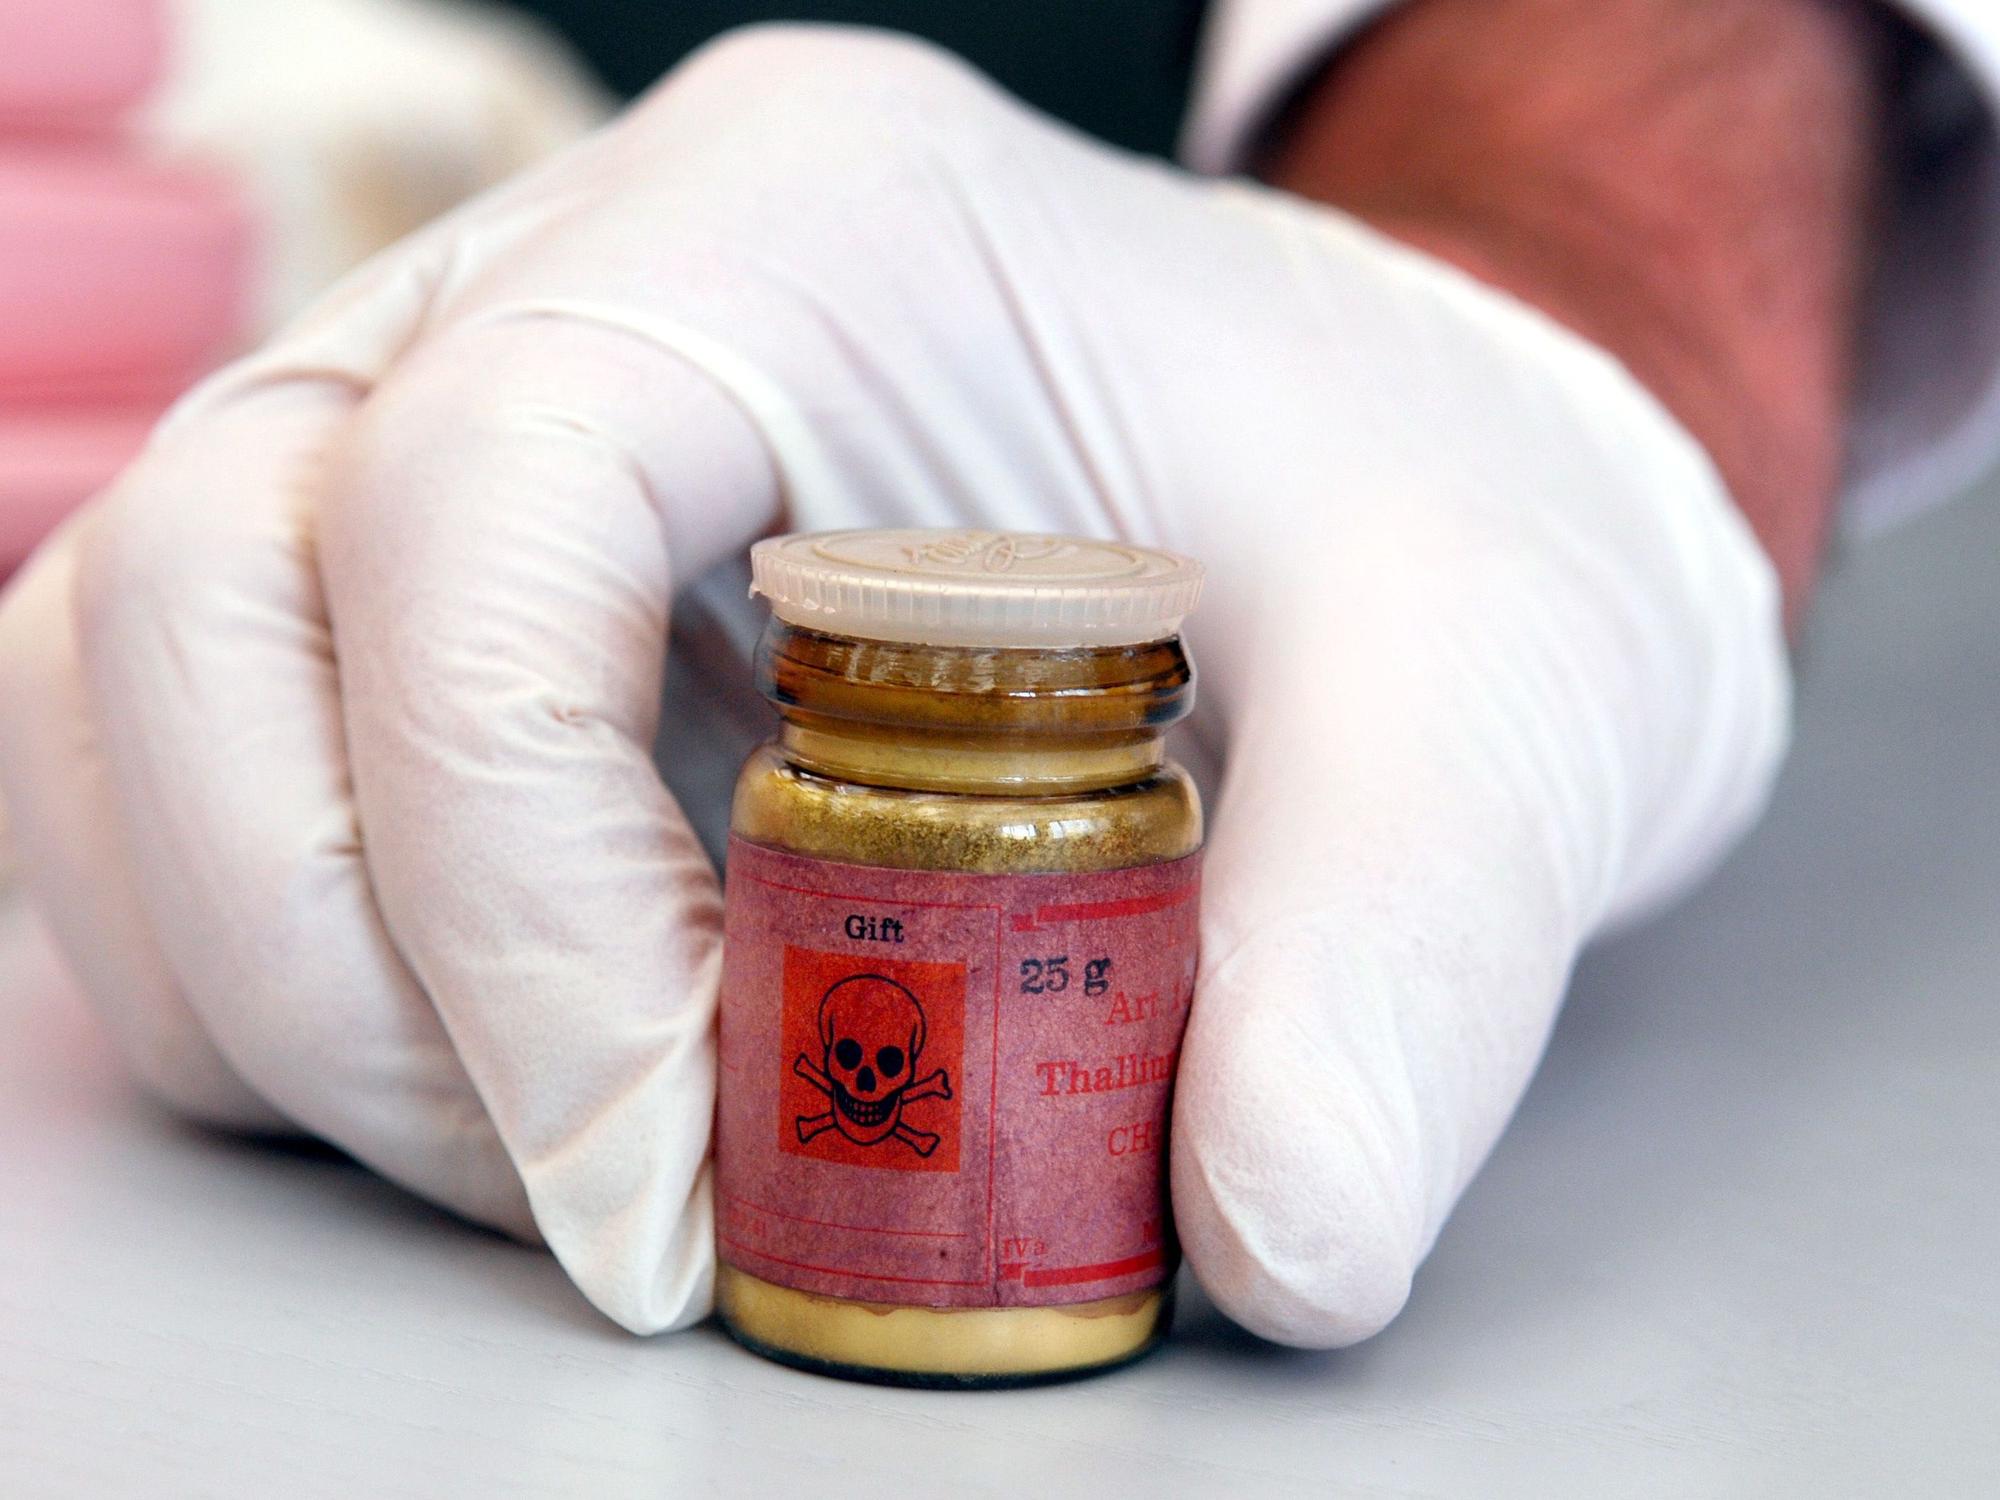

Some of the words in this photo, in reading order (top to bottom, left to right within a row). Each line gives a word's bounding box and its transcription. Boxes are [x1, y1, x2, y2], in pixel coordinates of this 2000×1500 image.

[844, 913, 905, 944] Gift
[1019, 957, 1070, 995] 25
[1084, 957, 1112, 997] g
